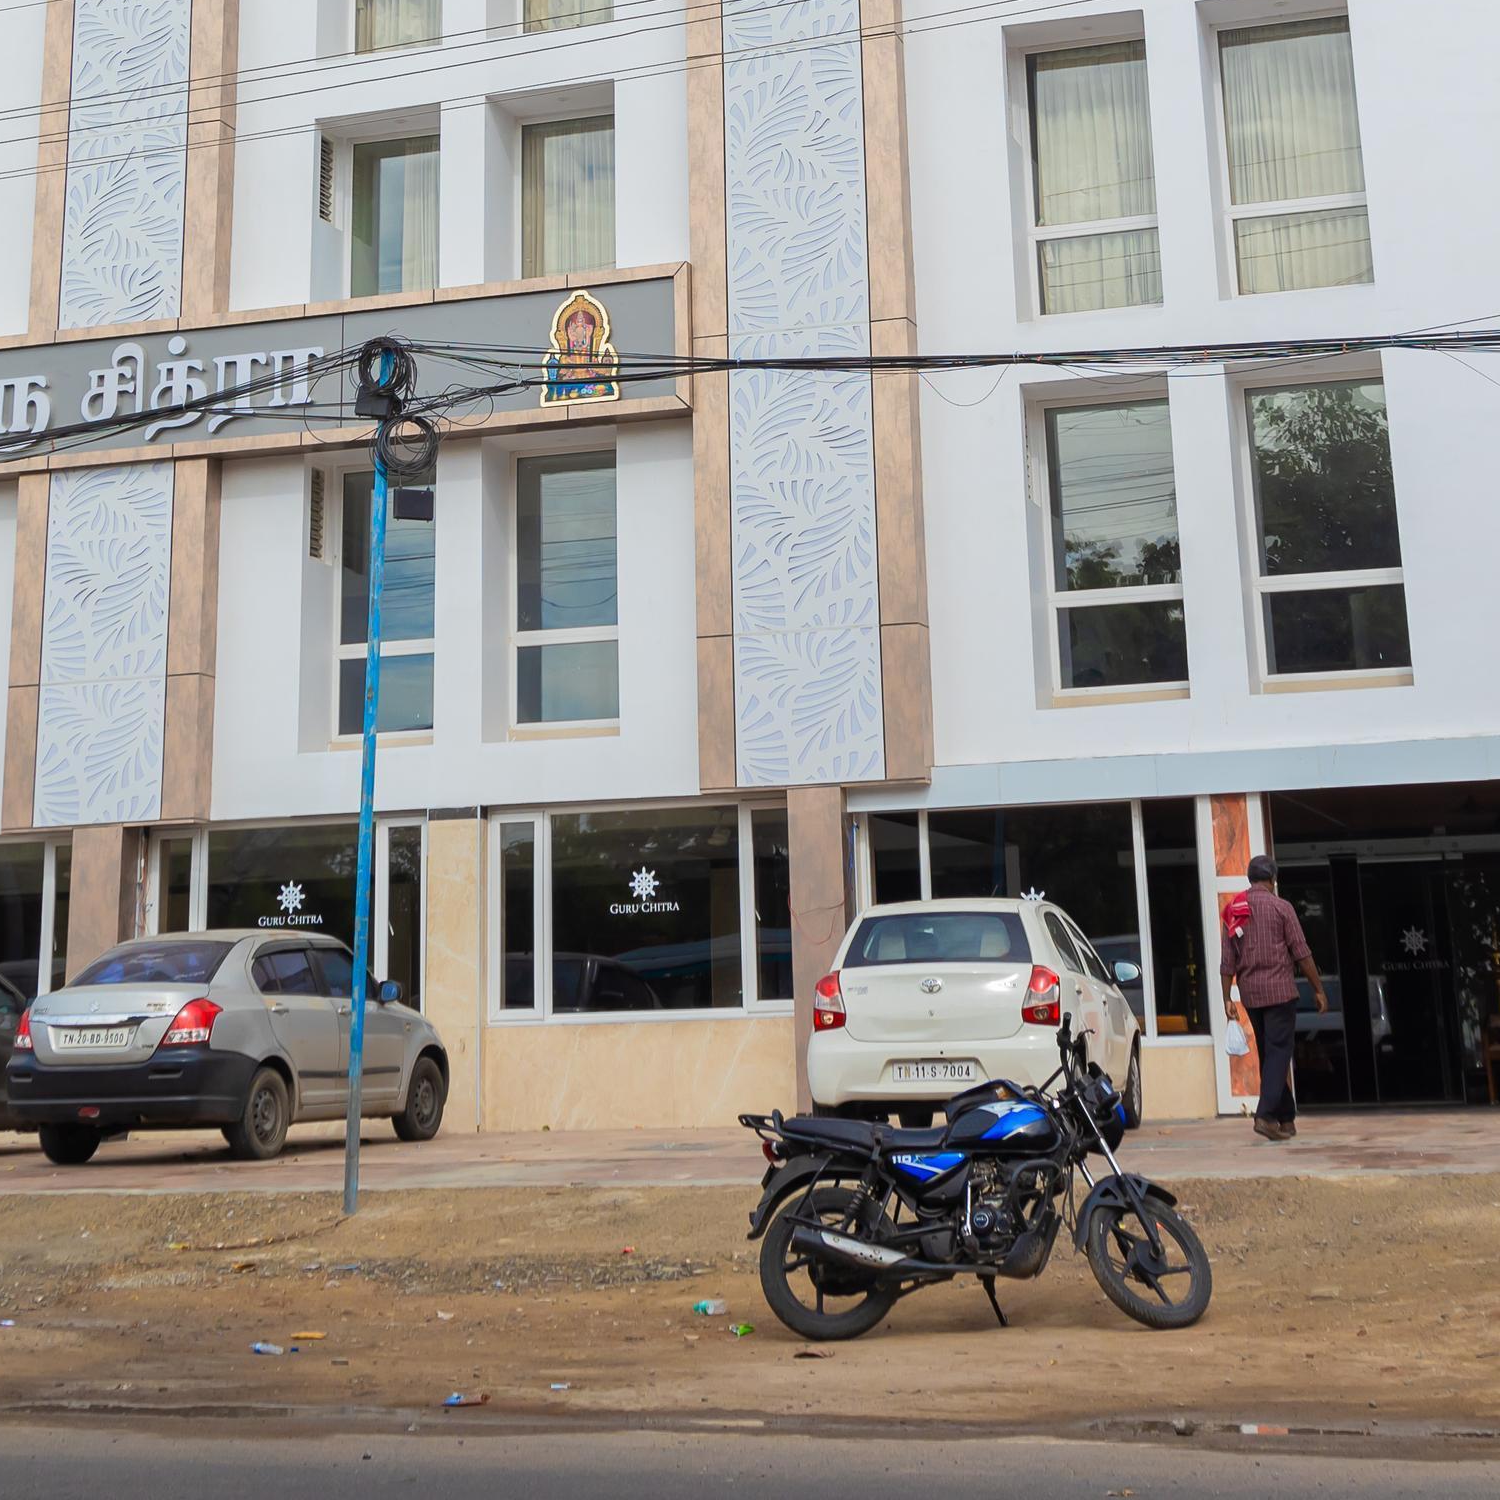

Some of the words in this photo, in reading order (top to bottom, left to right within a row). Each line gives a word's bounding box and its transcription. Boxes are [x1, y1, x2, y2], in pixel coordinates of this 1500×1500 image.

[80, 335, 326, 441] சித்ரா
[609, 903, 639, 914] GURU
[641, 901, 680, 912] CHITRA
